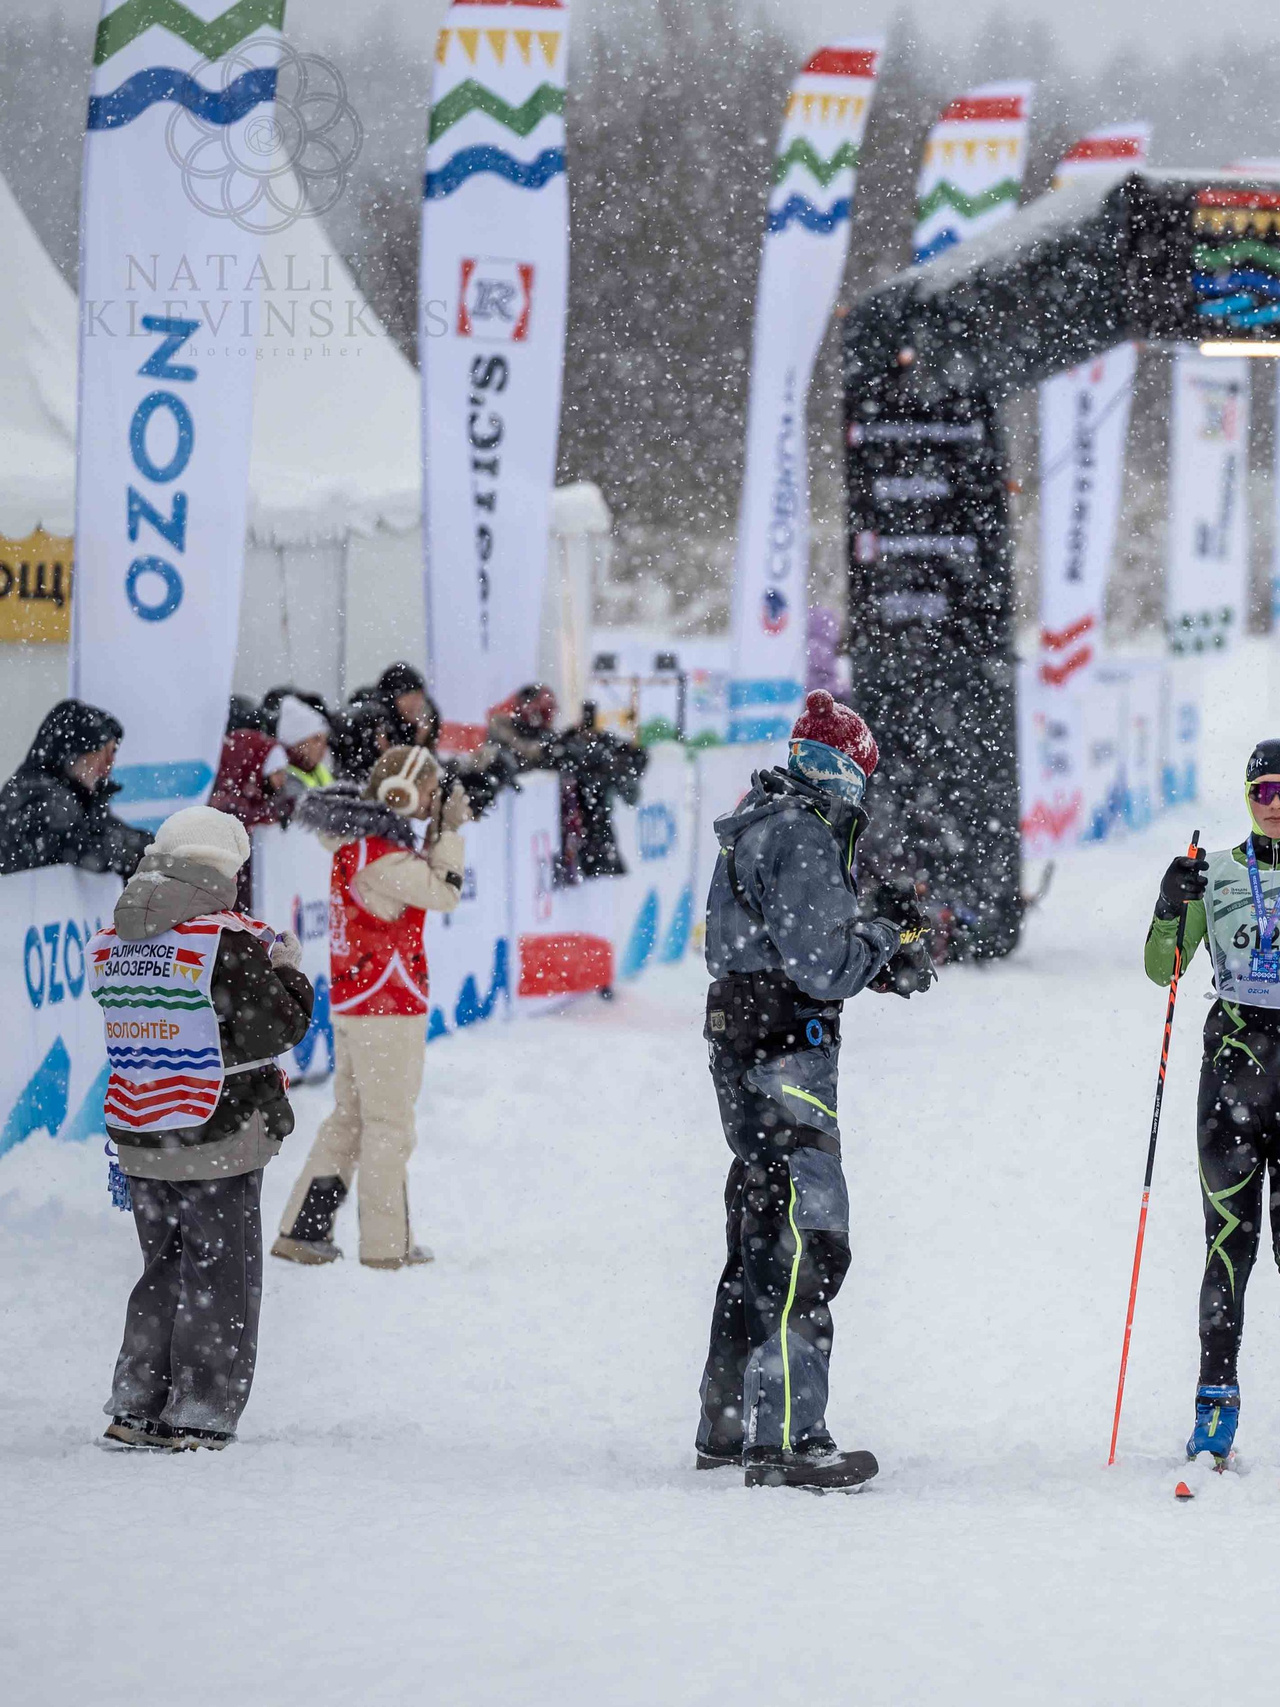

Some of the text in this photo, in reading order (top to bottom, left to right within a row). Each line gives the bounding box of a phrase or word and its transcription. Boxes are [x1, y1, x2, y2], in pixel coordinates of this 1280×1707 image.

[125, 313, 202, 624] OZON
[110, 944, 175, 960] ГАЛИЧСКОЕ
[105, 961, 171, 978] ЗАОЗЕРЬЕ
[106, 1019, 181, 1041] ВОЛОНТЁР
